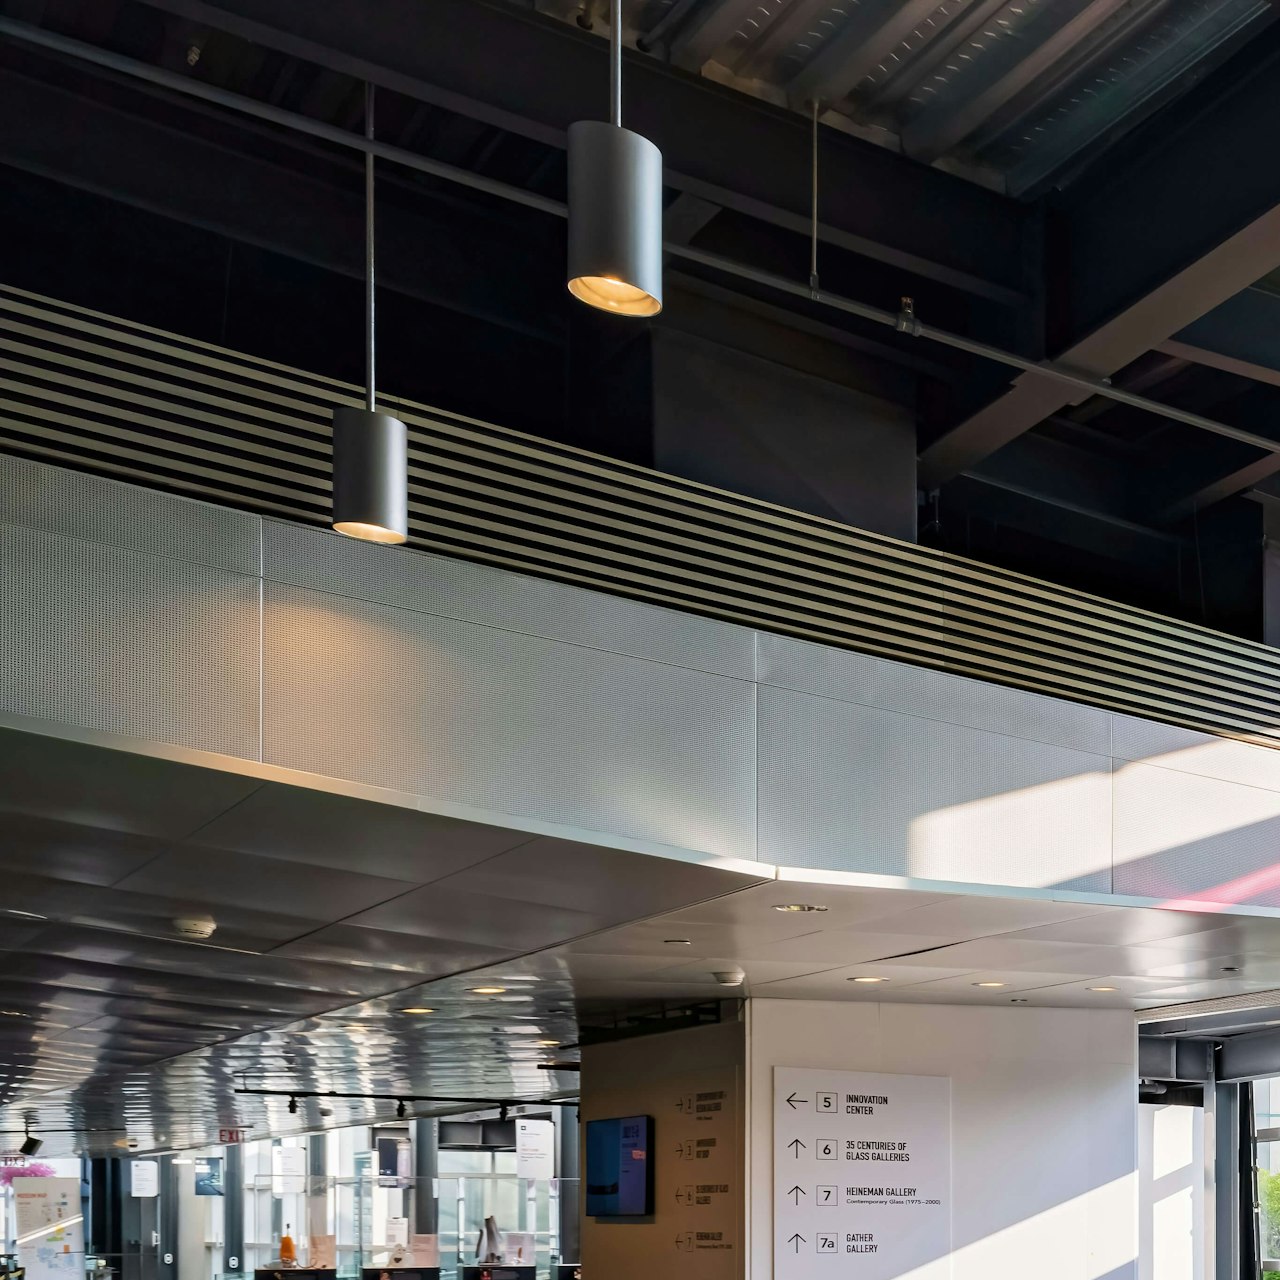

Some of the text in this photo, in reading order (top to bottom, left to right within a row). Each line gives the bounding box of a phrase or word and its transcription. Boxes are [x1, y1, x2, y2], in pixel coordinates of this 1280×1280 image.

[823, 1097, 831, 1108] 5
[846, 1094, 888, 1105] INNOVATION
[846, 1105, 874, 1115] CENTER
[219, 1129, 246, 1142] EXIT
[823, 1144, 831, 1155] 6
[846, 1140, 907, 1151] 35 CENTURIES OF
[846, 1152, 910, 1162] GLASS GALLERIES
[823, 1190, 831, 1201] 7
[846, 1187, 917, 1197] HEINEMAN GALLERY
[820, 1238, 835, 1249] 7a
[846, 1233, 874, 1243] GATHER
[846, 1244, 878, 1254] GALLERY
